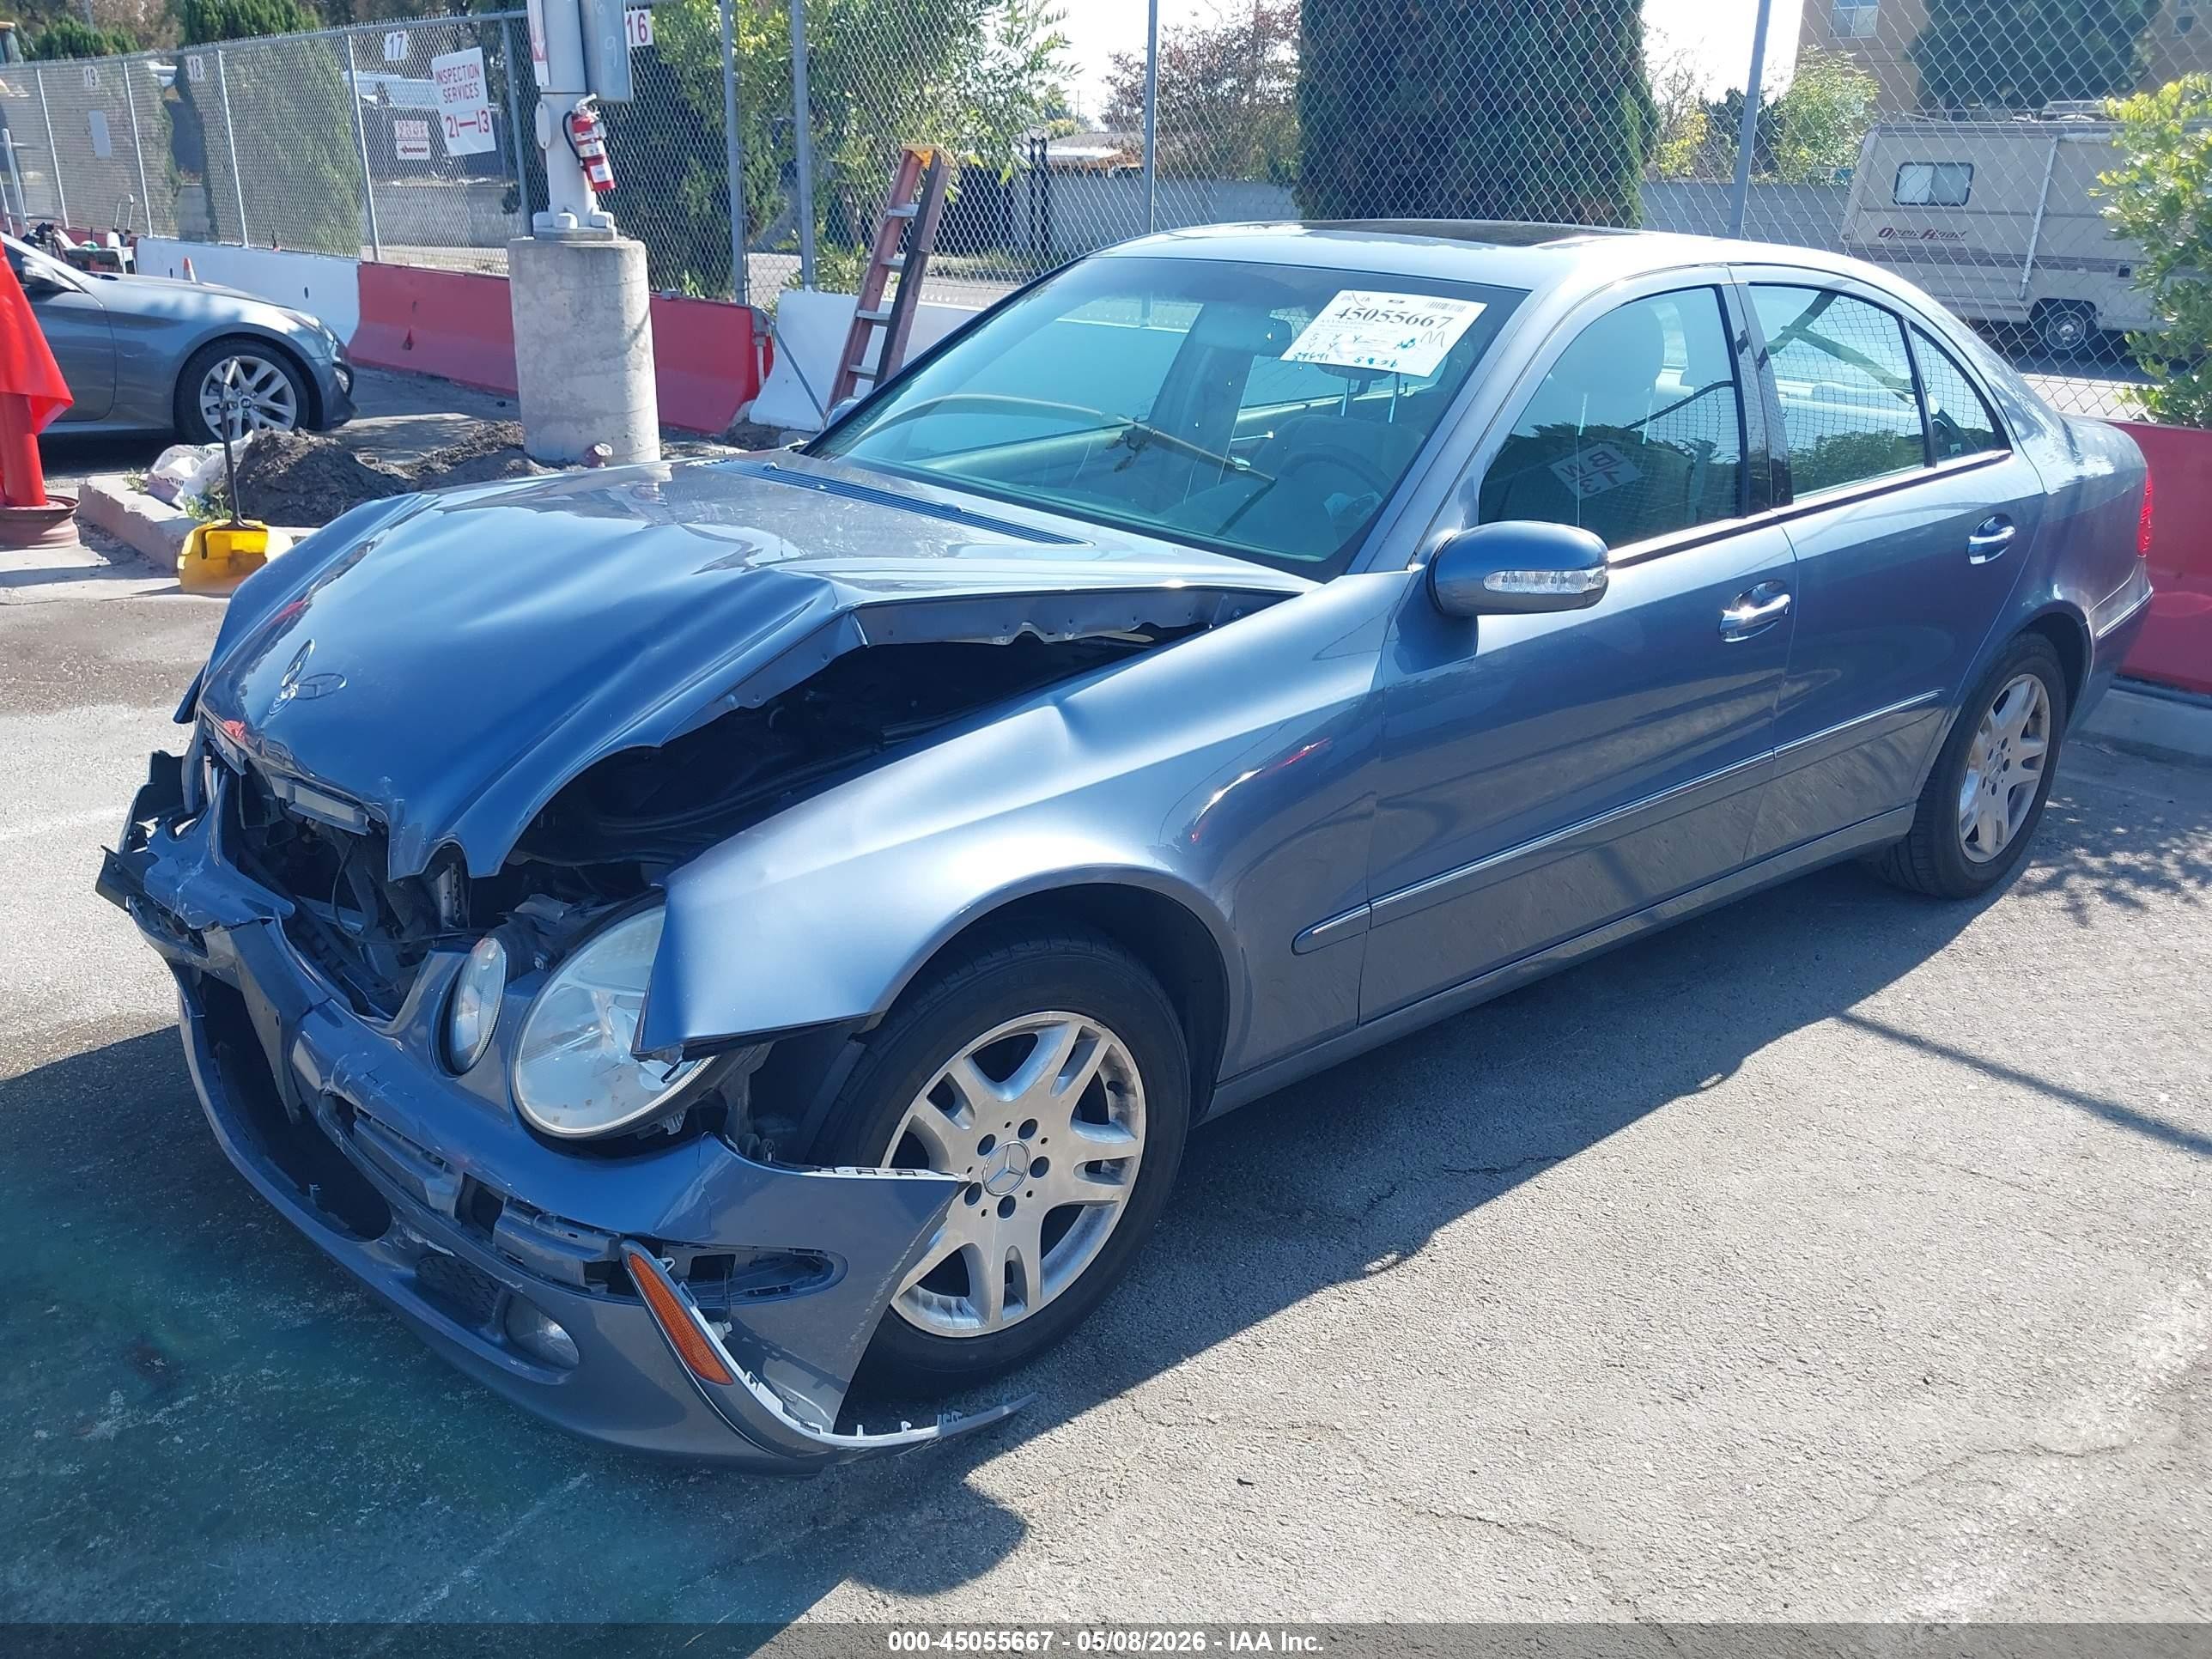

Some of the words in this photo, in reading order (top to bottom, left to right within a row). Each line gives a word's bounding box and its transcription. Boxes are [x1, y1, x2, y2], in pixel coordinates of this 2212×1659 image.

[627, 12, 647, 44] 16
[389, 33, 404, 59] 17
[85, 68, 97, 87] 19
[189, 58, 200, 78] 18
[435, 62, 480, 85] INSPECTION
[442, 82, 480, 104] SERVICES
[1878, 227, 1920, 240] Open
[1919, 228, 1967, 240] Road
[1334, 307, 1454, 330] 45055667
